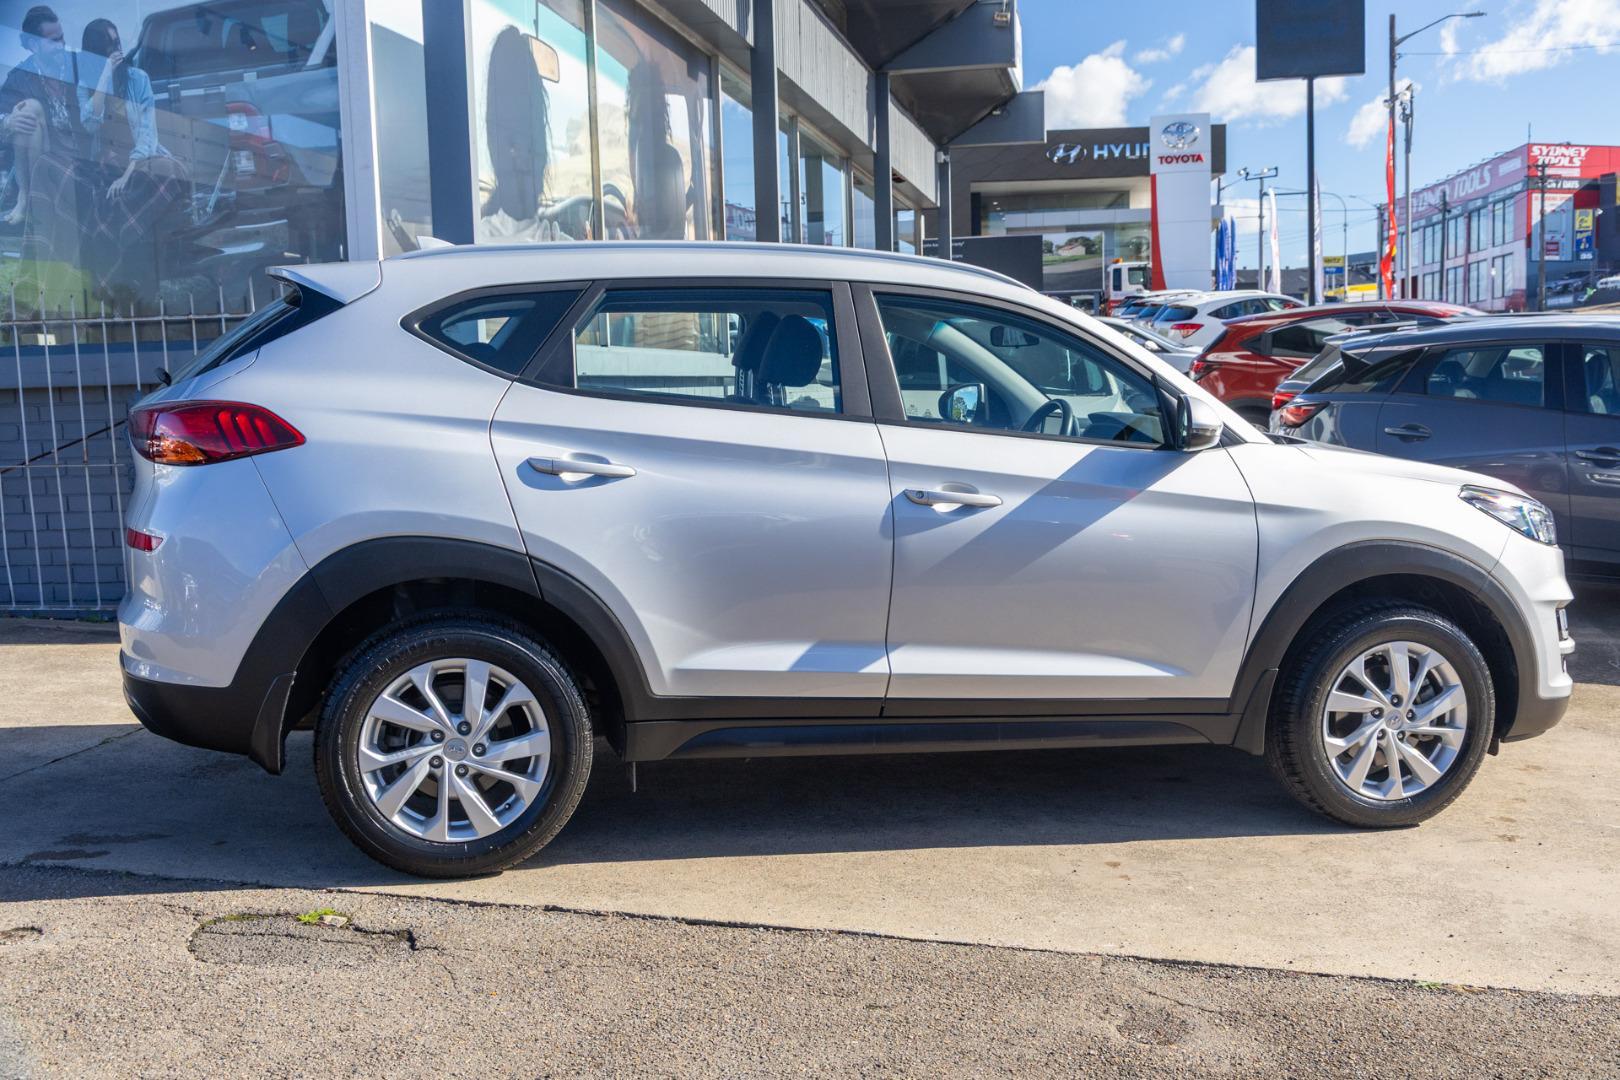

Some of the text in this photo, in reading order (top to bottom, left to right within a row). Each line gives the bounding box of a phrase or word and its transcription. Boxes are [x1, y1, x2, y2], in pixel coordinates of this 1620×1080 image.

[1530, 145, 1590, 157] SYDNEY
[1158, 153, 1203, 165] TOYOTA
[1536, 156, 1583, 167] TOOLS
[1453, 165, 1493, 200] TOOLS
